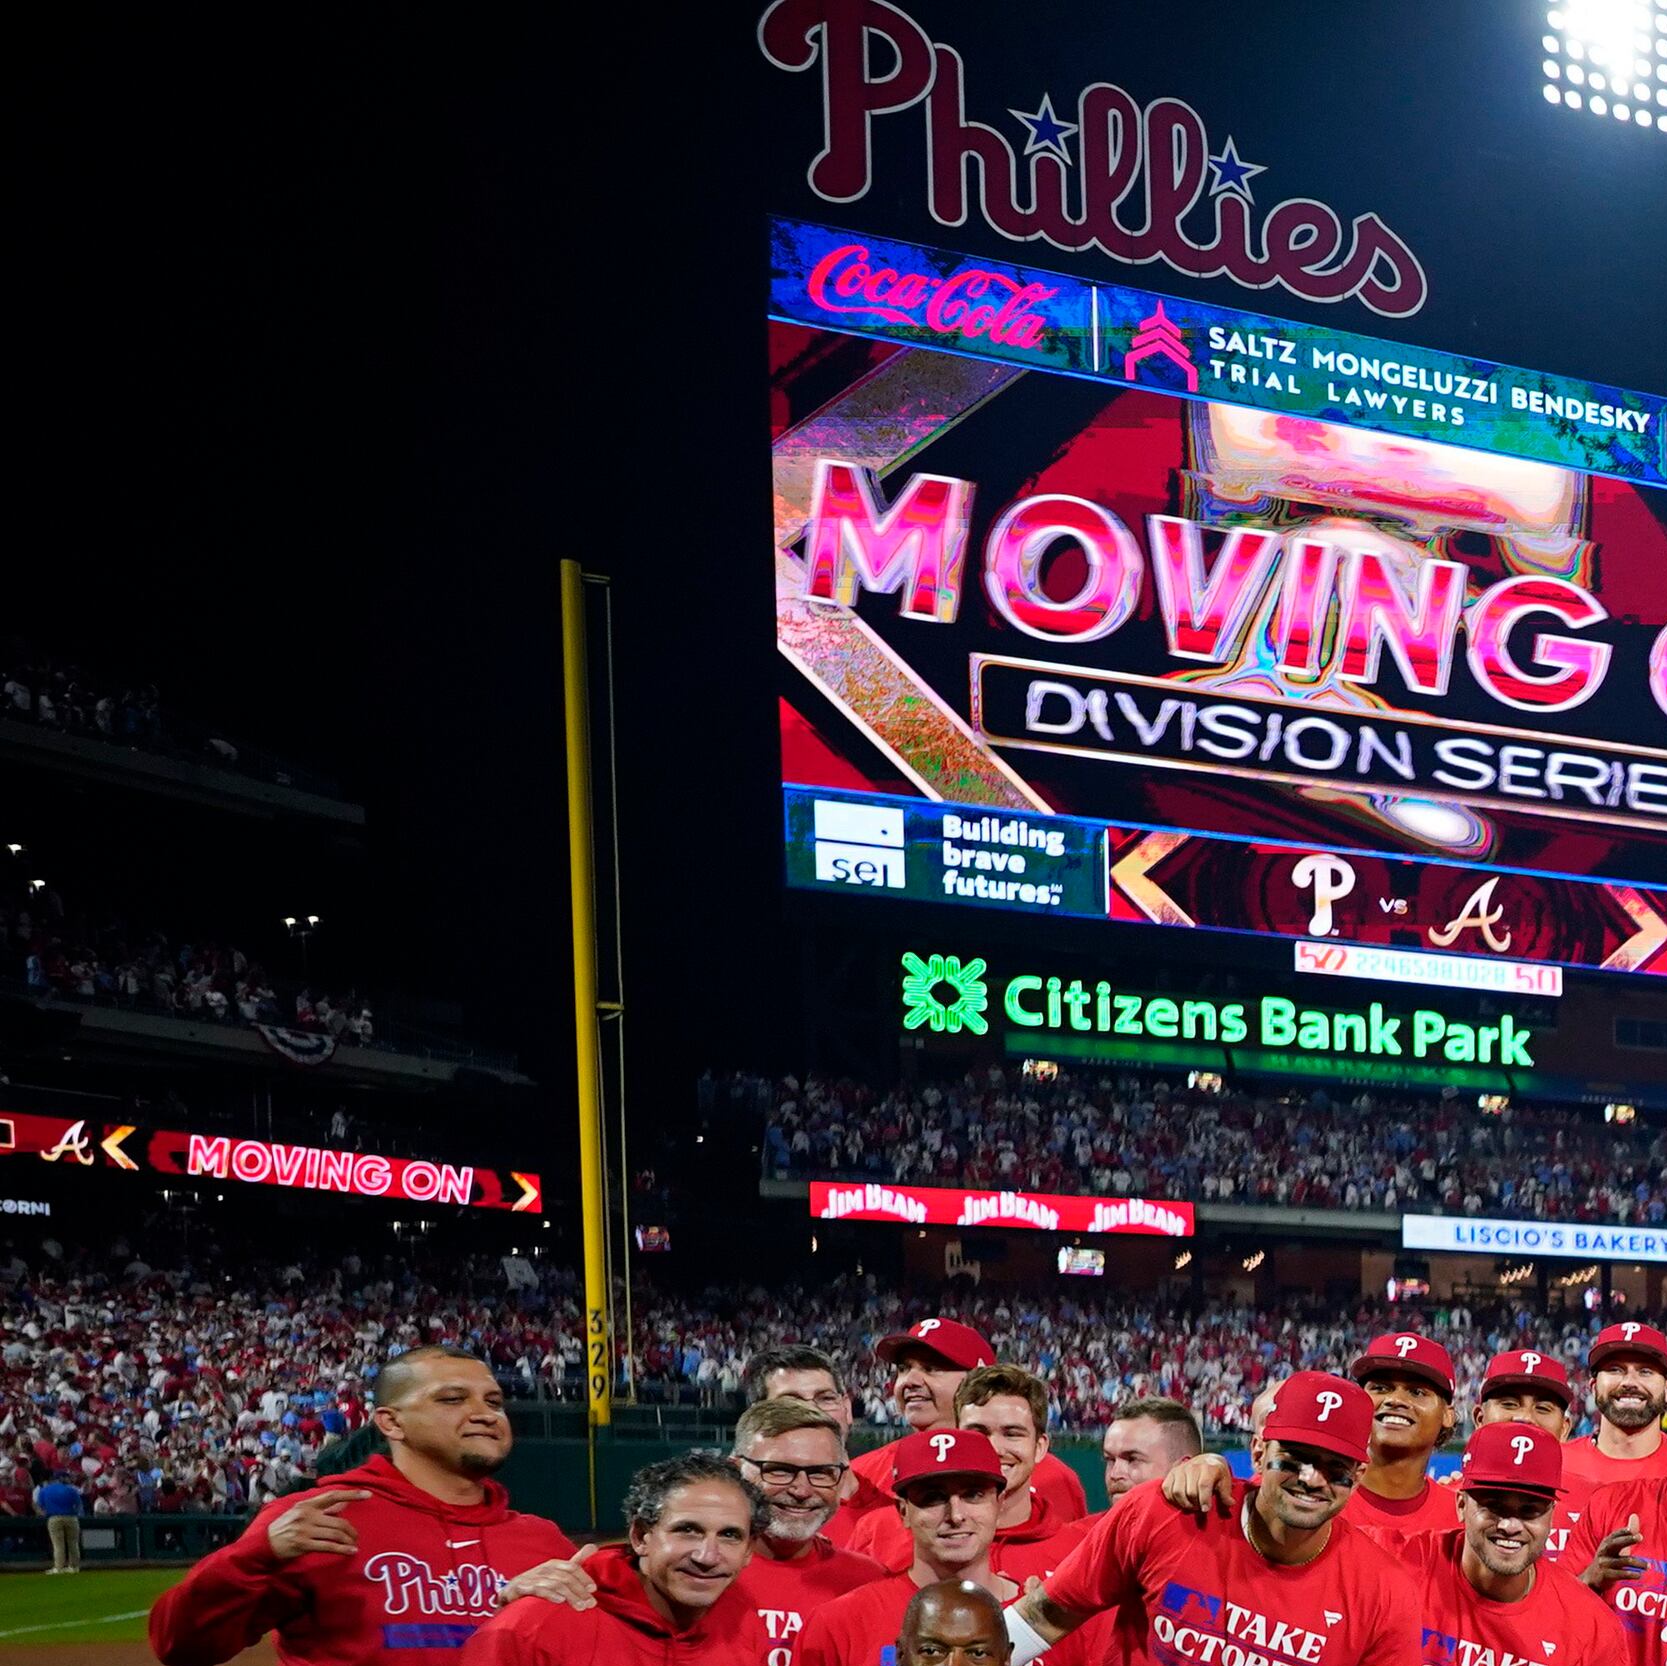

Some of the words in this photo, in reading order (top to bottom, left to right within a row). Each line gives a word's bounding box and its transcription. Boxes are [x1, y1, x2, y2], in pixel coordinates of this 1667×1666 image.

[757, 0, 1428, 318] Phillies
[1208, 327, 1297, 365] SALTZ
[1312, 350, 1497, 404] MONGELUZZI
[1511, 387, 1651, 434] BENDESKY
[1210, 359, 1301, 395] TRIAL
[1328, 384, 1466, 426] LAWYERS
[803, 459, 1612, 713] MOVING
[1024, 680, 1413, 772] DIVISION
[942, 815, 1066, 857] Building
[942, 842, 1027, 875] brave
[1004, 976, 1248, 1043] Citizens
[1261, 997, 1402, 1055] Bank
[1414, 1010, 1532, 1067] Park
[187, 1134, 393, 1197] MOVING
[402, 1158, 474, 1206] ON
[821, 1188, 863, 1219] JIM
[864, 1184, 928, 1224] BEAM
[957, 1197, 999, 1226] JIM
[999, 1191, 1059, 1231] BEAM
[1088, 1203, 1128, 1233] JIM
[1127, 1199, 1187, 1237] BEAM
[1455, 1225, 1565, 1251] LISCIO'S
[1227, 1602, 1326, 1663] TAKE
